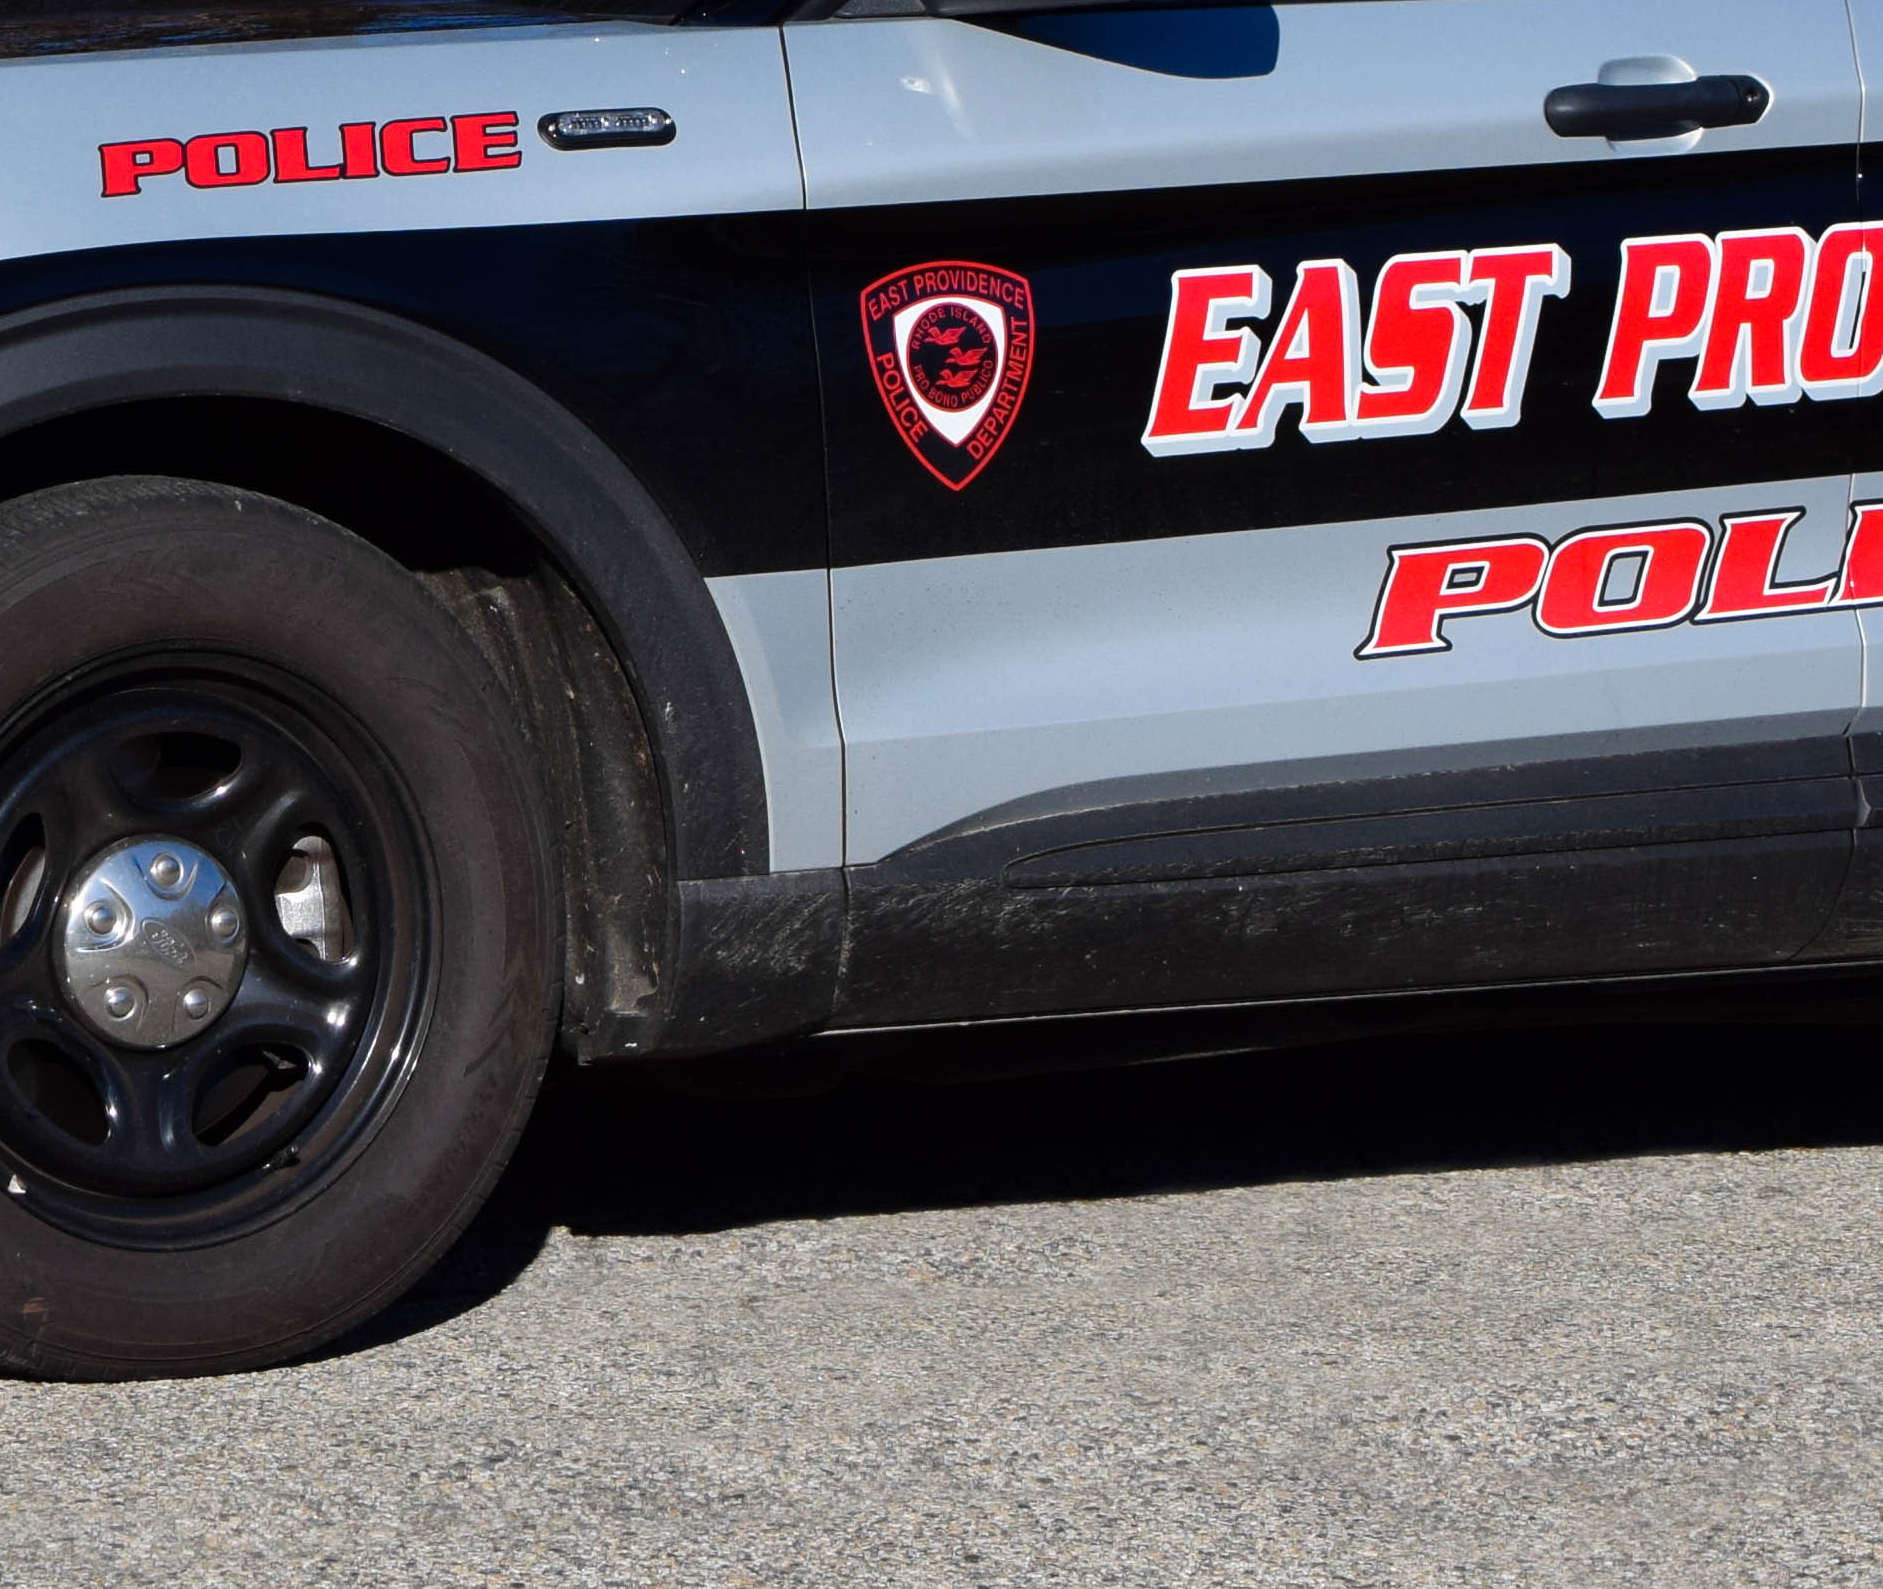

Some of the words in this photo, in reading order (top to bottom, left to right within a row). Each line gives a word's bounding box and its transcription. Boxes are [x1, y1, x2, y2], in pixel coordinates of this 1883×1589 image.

[98, 111, 523, 197] POLICE
[868, 279, 909, 321] EAST
[913, 269, 1025, 309] PROVIDENCE
[911, 307, 947, 350] RHODE
[950, 306, 991, 344] ISLAND
[912, 364, 930, 392] PRO
[961, 360, 993, 403] PUBLICO
[966, 315, 1028, 460] DEPARTMENT
[1141, 240, 1571, 456] EAST
[877, 351, 929, 443] POLICE
